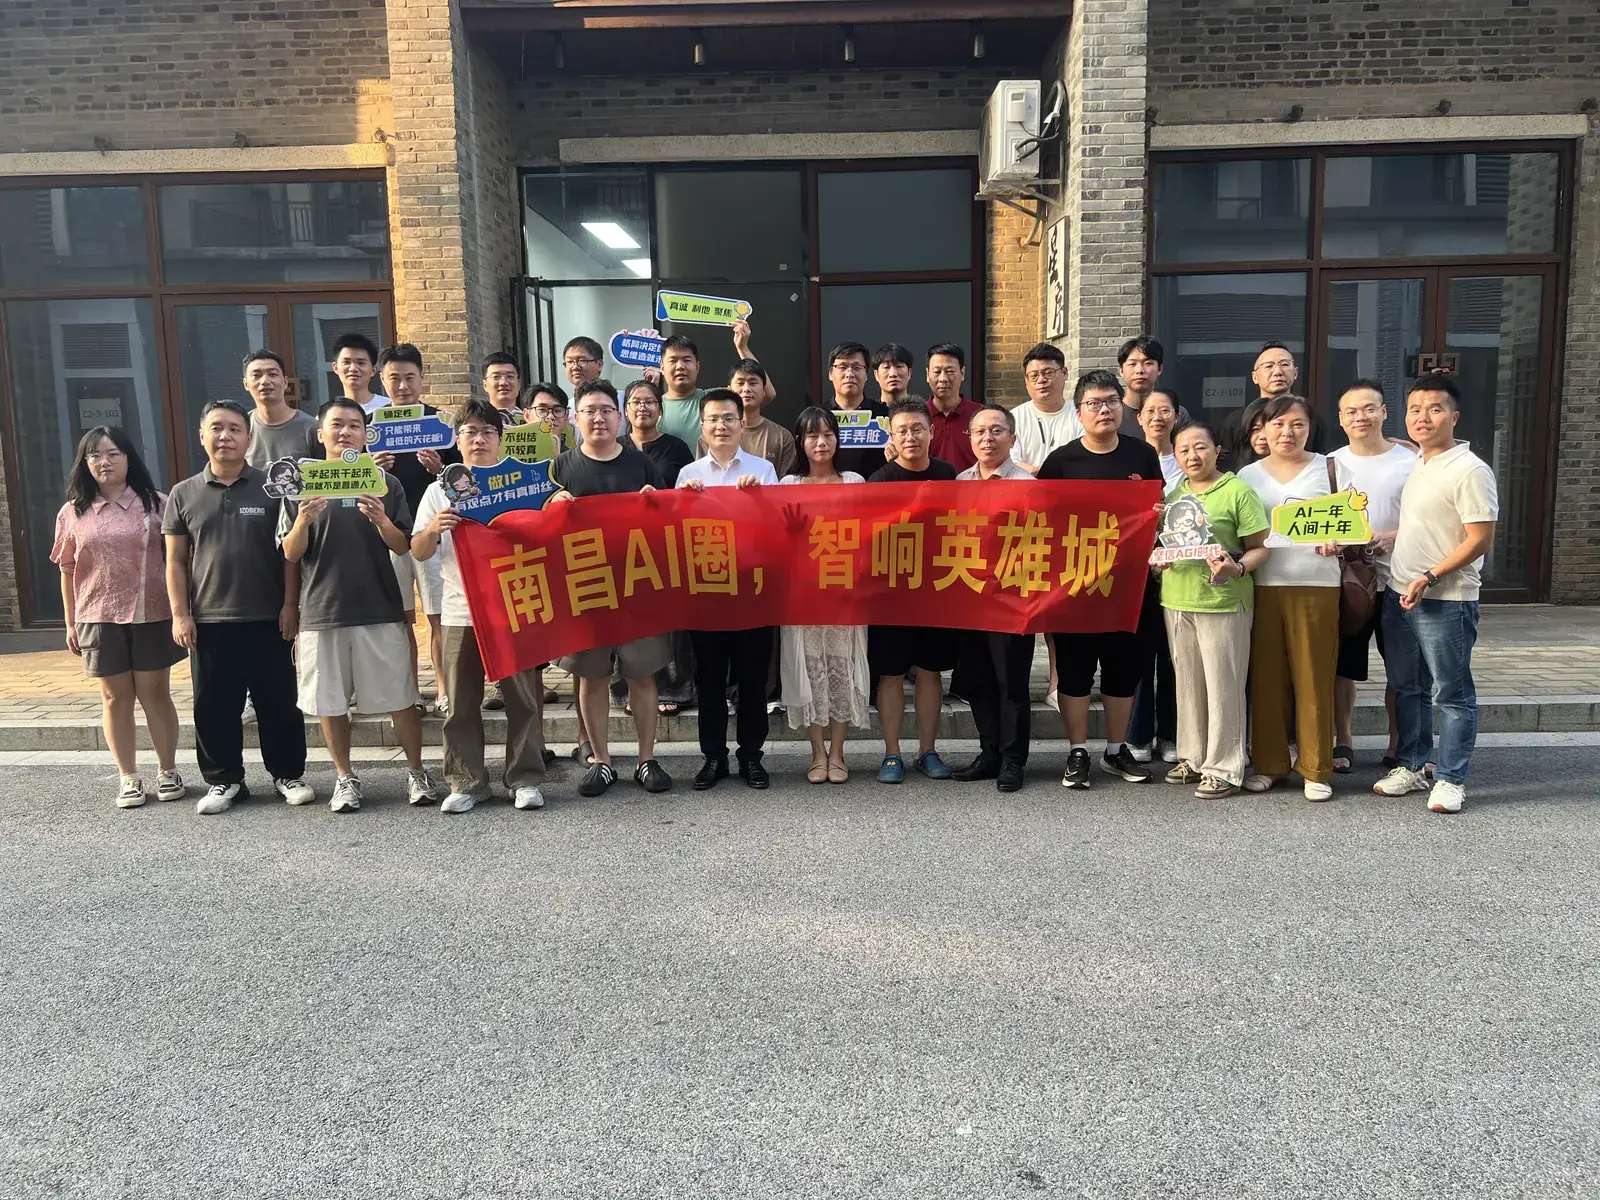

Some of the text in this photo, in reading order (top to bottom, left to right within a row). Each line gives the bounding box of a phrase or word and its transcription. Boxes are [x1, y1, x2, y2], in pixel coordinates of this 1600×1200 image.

[669, 301, 688, 312] 真诚
[714, 307, 732, 318] 聚焦
[1205, 388, 1243, 397] C2-3-103
[83, 409, 119, 418] C2-3-101
[383, 409, 412, 419] 确定性
[385, 424, 421, 436] 只能带来
[839, 429, 881, 443] 手弄脏
[505, 432, 537, 443] 不纠结
[505, 445, 537, 456] 不较真
[308, 468, 372, 479] 学起来干起来
[305, 480, 376, 491] 你就不是普通人了
[488, 471, 522, 491] 做IP
[454, 480, 553, 511] 有观点才有真粉丝
[1295, 505, 1344, 518] AI一年
[1287, 520, 1352, 536] 人间十年
[1154, 545, 1220, 561] 坚信AGI时代
